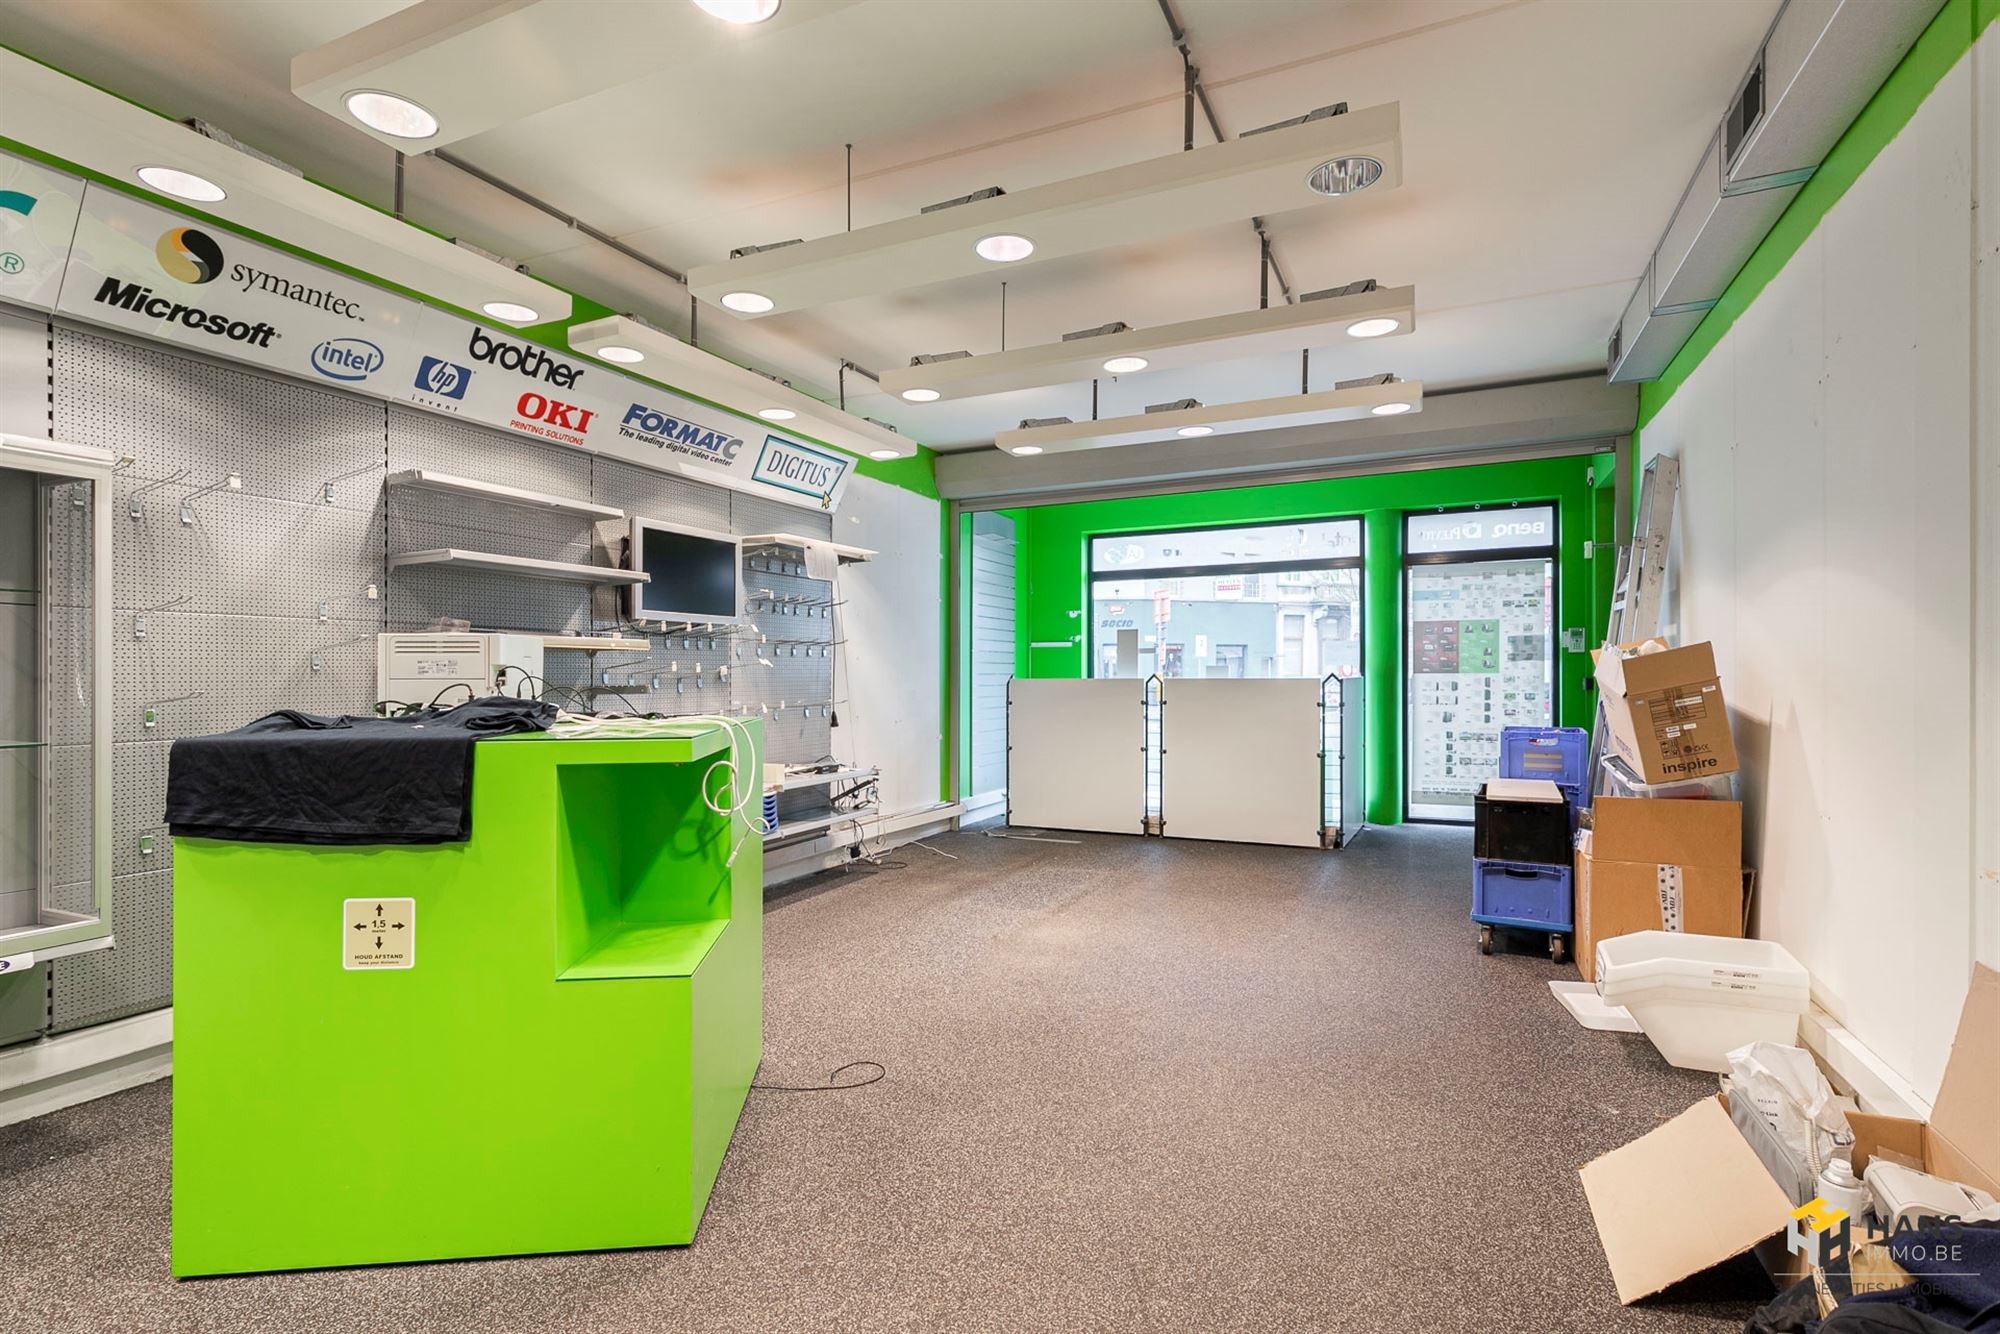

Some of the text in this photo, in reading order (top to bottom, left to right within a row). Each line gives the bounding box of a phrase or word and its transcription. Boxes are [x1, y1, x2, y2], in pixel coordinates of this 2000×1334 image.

[230, 262, 360, 320] symantec
[94, 276, 276, 348] Microsoft
[322, 341, 374, 373] intel
[469, 326, 585, 390] brother
[431, 361, 457, 395] hp
[411, 394, 458, 413] invent
[516, 392, 594, 434] OKI
[509, 419, 585, 446] PRINTING SOLUTIONS
[618, 427, 733, 467] The leading digital video center
[766, 450, 831, 487] DIGITUS
[1101, 619, 1134, 628] SOCIO
[1662, 757, 1718, 774] inspire
